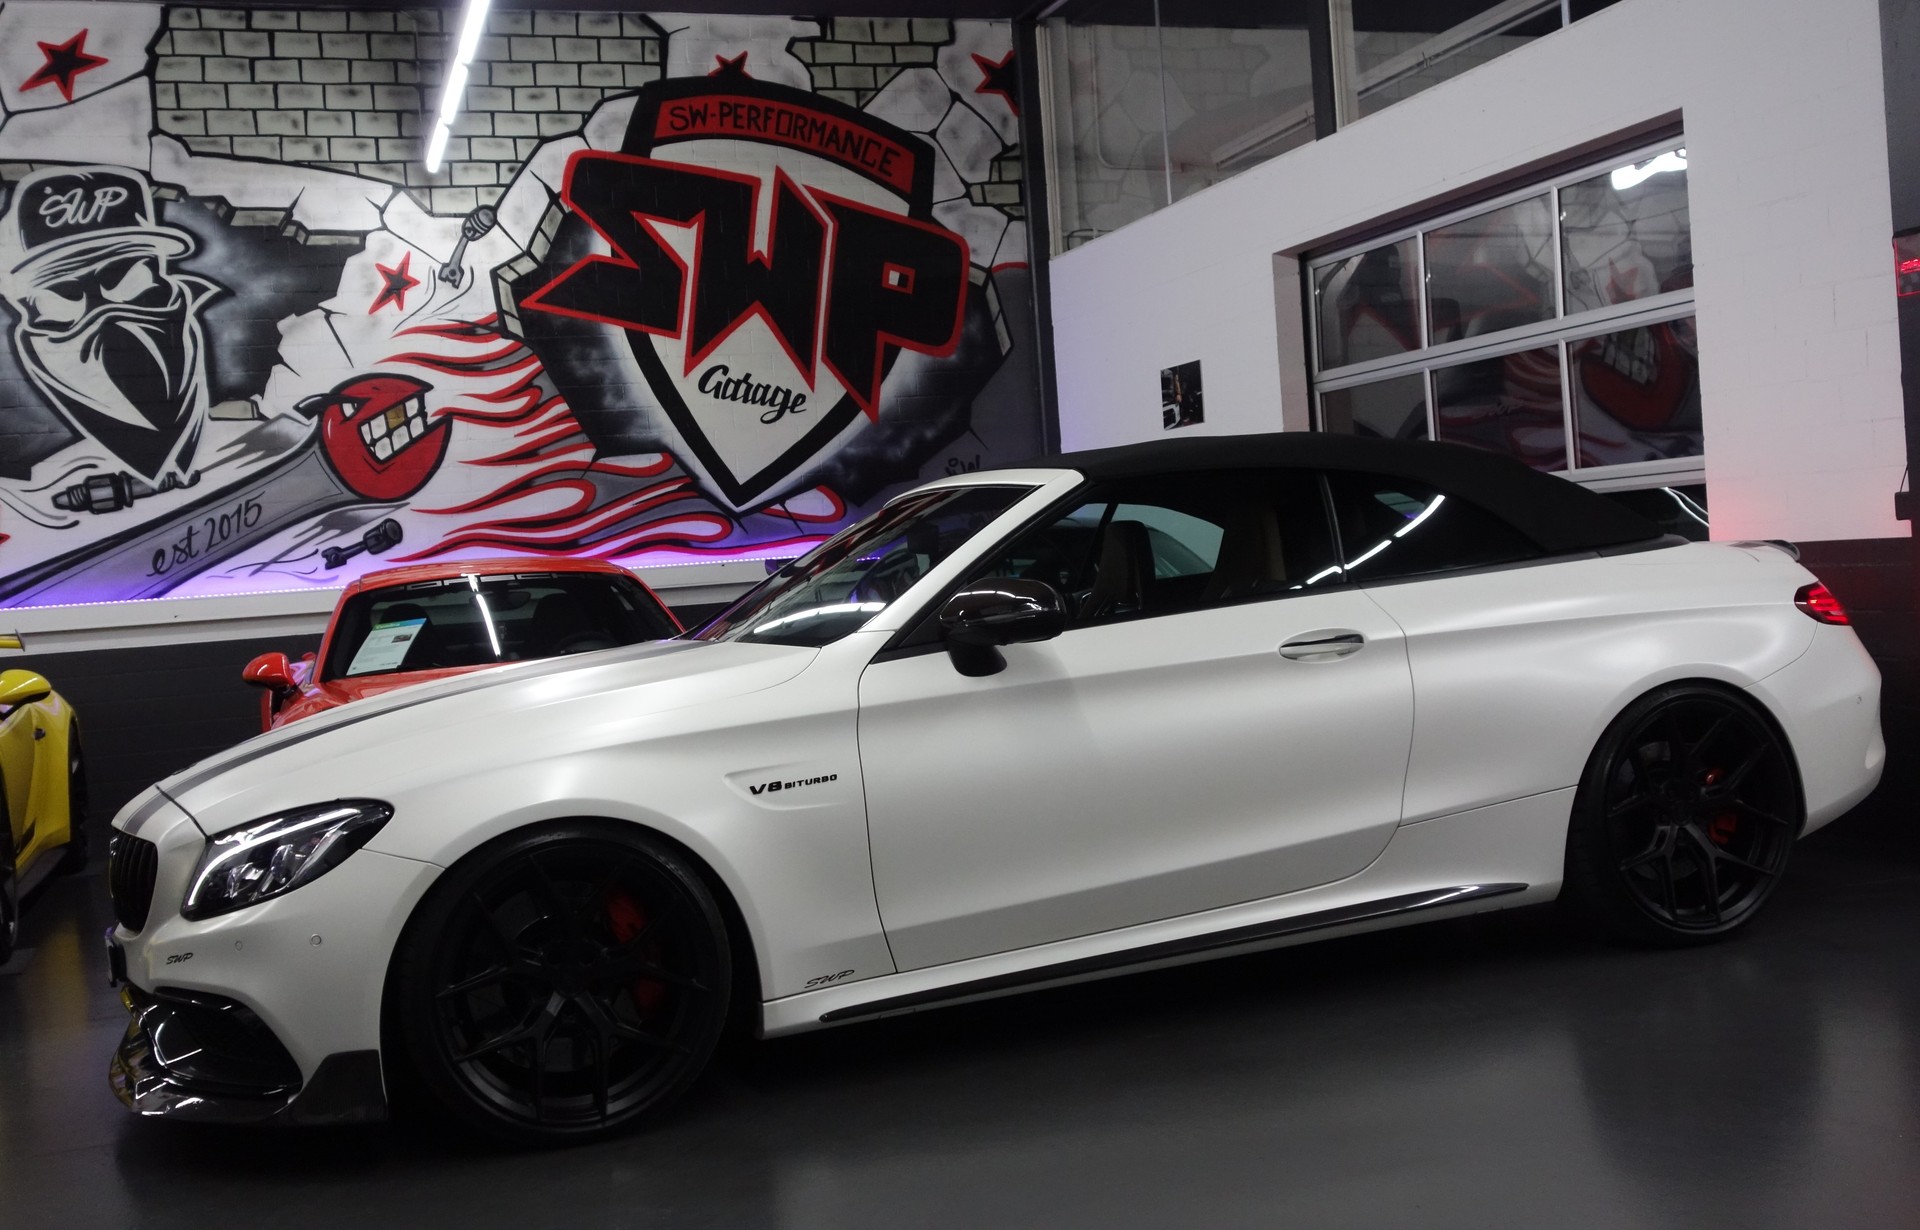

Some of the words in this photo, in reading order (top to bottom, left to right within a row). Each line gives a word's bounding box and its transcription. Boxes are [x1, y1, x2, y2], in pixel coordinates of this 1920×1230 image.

[669, 101, 901, 178] SW-PERFORMANCE
[38, 186, 128, 228] SWP
[520, 148, 971, 425] SWP
[697, 364, 807, 425] Garage
[145, 525, 201, 577] est
[203, 490, 266, 553] 2015
[749, 780, 783, 795] V8
[784, 773, 838, 790] BITURBO
[165, 952, 194, 965] SWP
[804, 969, 855, 989] SWP
